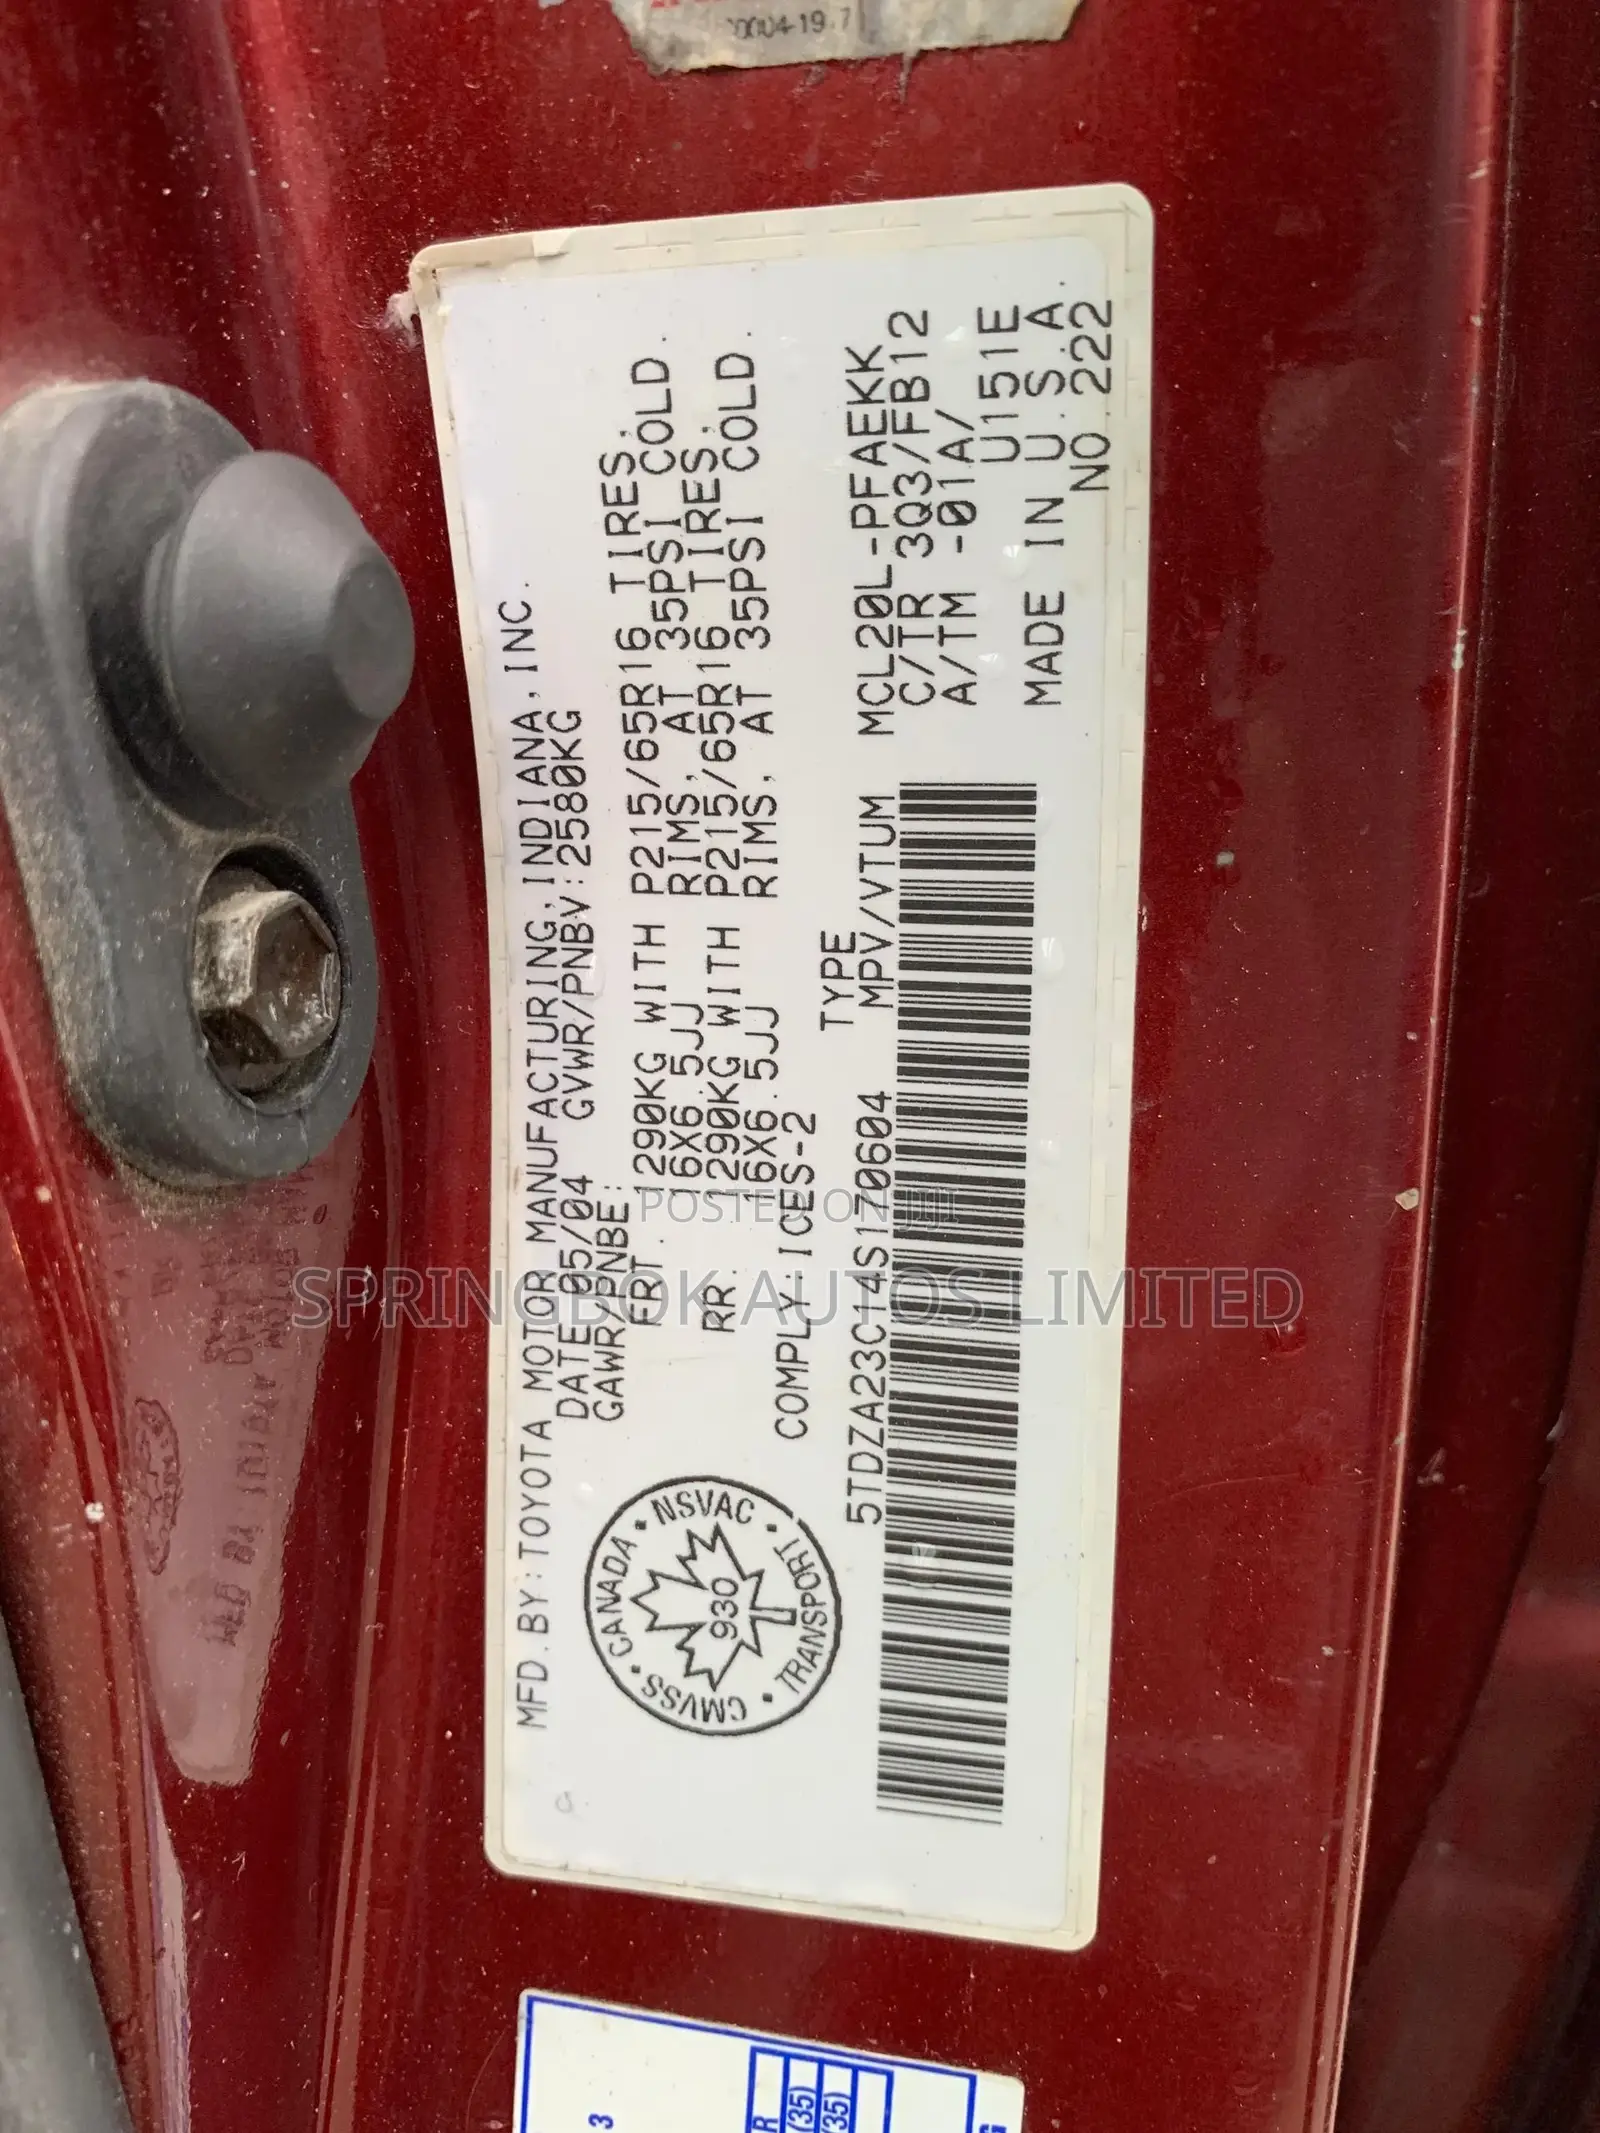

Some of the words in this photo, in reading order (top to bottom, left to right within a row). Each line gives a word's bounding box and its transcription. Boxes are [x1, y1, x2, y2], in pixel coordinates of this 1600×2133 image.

[630, 337, 677, 476] COLD.
[714, 332, 760, 473] COLD.
[976, 304, 1021, 463] U151E
[598, 430, 646, 595] TIRES,
[679, 426, 726, 593] TIRES,
[844, 344, 896, 736] MCL20L-PFAEKK
[1024, 497, 1065, 548] IN
[643, 517, 691, 651] 35PSI
[725, 516, 771, 650] 35PSI
[656, 684, 696, 735] AT
[735, 684, 774, 735] AT
[896, 593, 937, 707] C/TR
[937, 592, 978, 706] A/TM
[1023, 590, 1065, 706] MADE
[614, 626, 665, 895] P215/65R16
[693, 625, 741, 897] P215/65R16
[664, 774, 703, 896] RIMS,
[741, 775, 779, 898] RIMS,
[857, 795, 897, 1009] MPV/VTUM
[632, 924, 667, 1024] WITH
[706, 926, 741, 1027] WITH
[819, 930, 857, 1032] TYPE
[632, 1051, 668, 1195] 1290KG
[668, 1002, 705, 1199] 16X6.5JJ
[704, 1055, 742, 1200] 1290KG
[742, 1005, 780, 1202] 16X6.5JJ
[557, 1174, 594, 1297] 05/04
[522, 1270, 558, 1392] MOTOR
[845, 1090, 893, 1525] 5TDZA23C14S170604
[555, 1322, 592, 1420] DATE
[650, 1489, 755, 1526] NSVAC
[595, 1536, 638, 1657] CANADA
[709, 1576, 739, 1640] 930
[772, 1538, 828, 1694] TRANSPORT
[641, 1674, 747, 1724] CMVSS
[588, 2113, 614, 2130] 3
[787, 2086, 816, 2132] (35)
